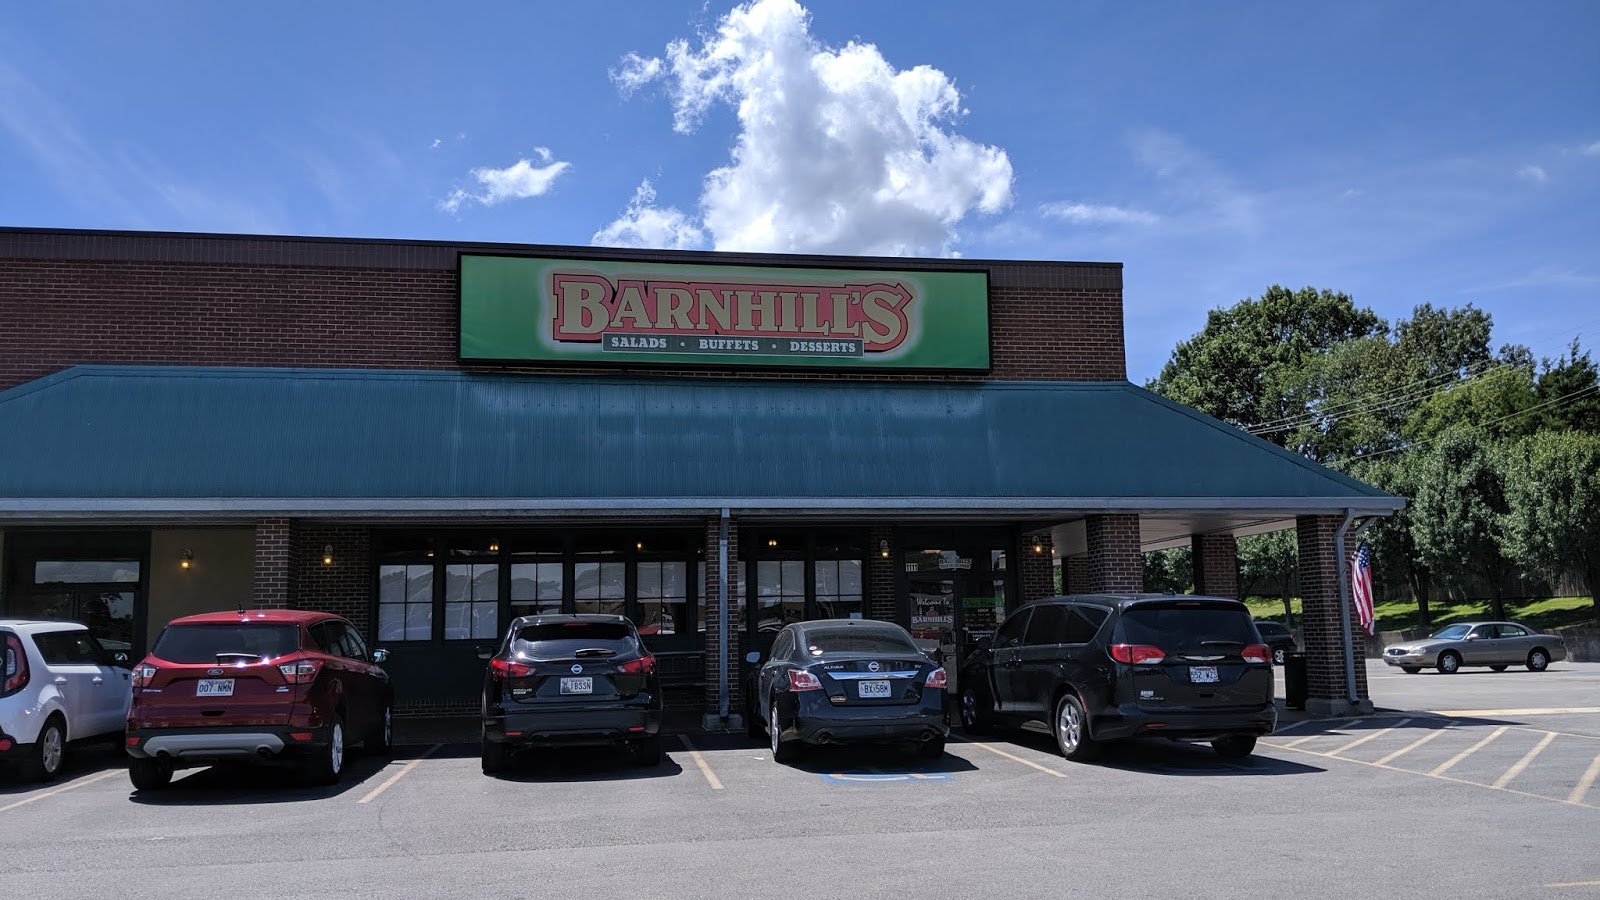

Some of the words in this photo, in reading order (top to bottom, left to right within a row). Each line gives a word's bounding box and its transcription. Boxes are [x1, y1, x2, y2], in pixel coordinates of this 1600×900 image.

[556, 279, 904, 345] BARNHILL'S
[611, 337, 667, 350] SALADS
[699, 338, 760, 352] BUFFETS
[789, 340, 857, 353] DESSERTS
[916, 597, 941, 606] Welcome
[942, 597, 950, 605] To
[199, 684, 213, 693] 007
